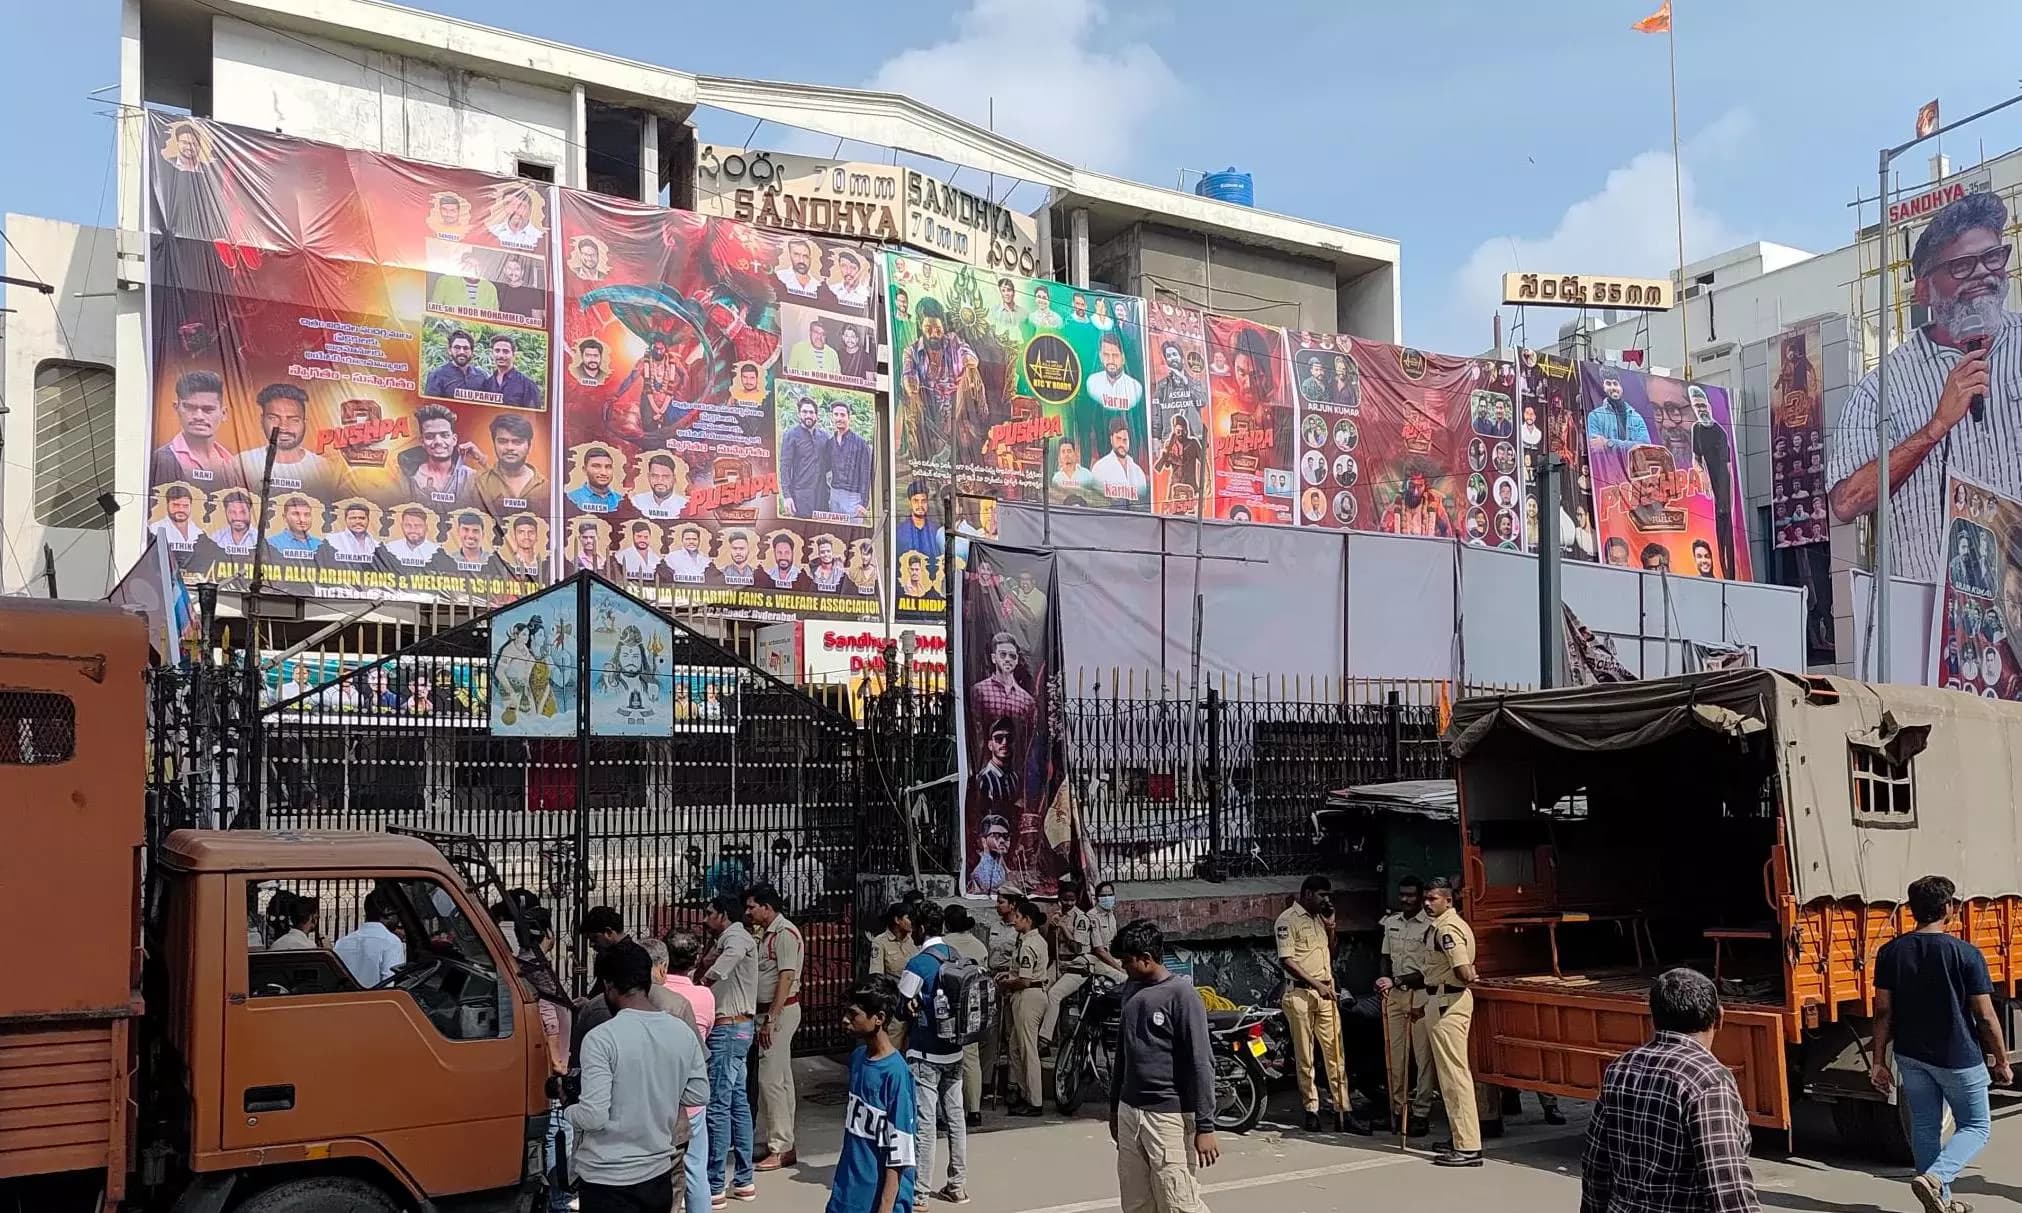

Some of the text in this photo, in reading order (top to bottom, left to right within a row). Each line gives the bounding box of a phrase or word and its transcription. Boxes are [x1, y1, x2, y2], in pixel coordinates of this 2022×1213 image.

[813, 165, 896, 200] 70mm
[734, 188, 899, 240] SANDHYA
[907, 171, 1017, 242] SANDHYA
[1889, 182, 1965, 224] SANDHYA
[911, 211, 969, 256] 70mm
[457, 306, 479, 316] NOOR
[480, 308, 525, 323] MOHAMMED
[455, 388, 503, 402] ALLU PARVEZ
[1308, 402, 1333, 413] ARJUN
[315, 416, 411, 456] PUSHPA
[989, 416, 1063, 450] PUSHPA
[1216, 428, 1274, 456] PUSHPA
[685, 472, 779, 516] PUSHPA
[335, 553, 373, 562] SRIKANTH
[217, 561, 240, 578] ALL
[284, 565, 317, 583] ALLU
[319, 568, 361, 587] ARJUN
[363, 571, 397, 588] FANS
[399, 577, 409, 590] &
[410, 574, 467, 593] WELFARE
[701, 590, 737, 606] ARJUN
[738, 591, 765, 609] FANS
[766, 596, 774, 609] &
[775, 593, 819, 613] WELFARE
[899, 598, 917, 610] ALL
